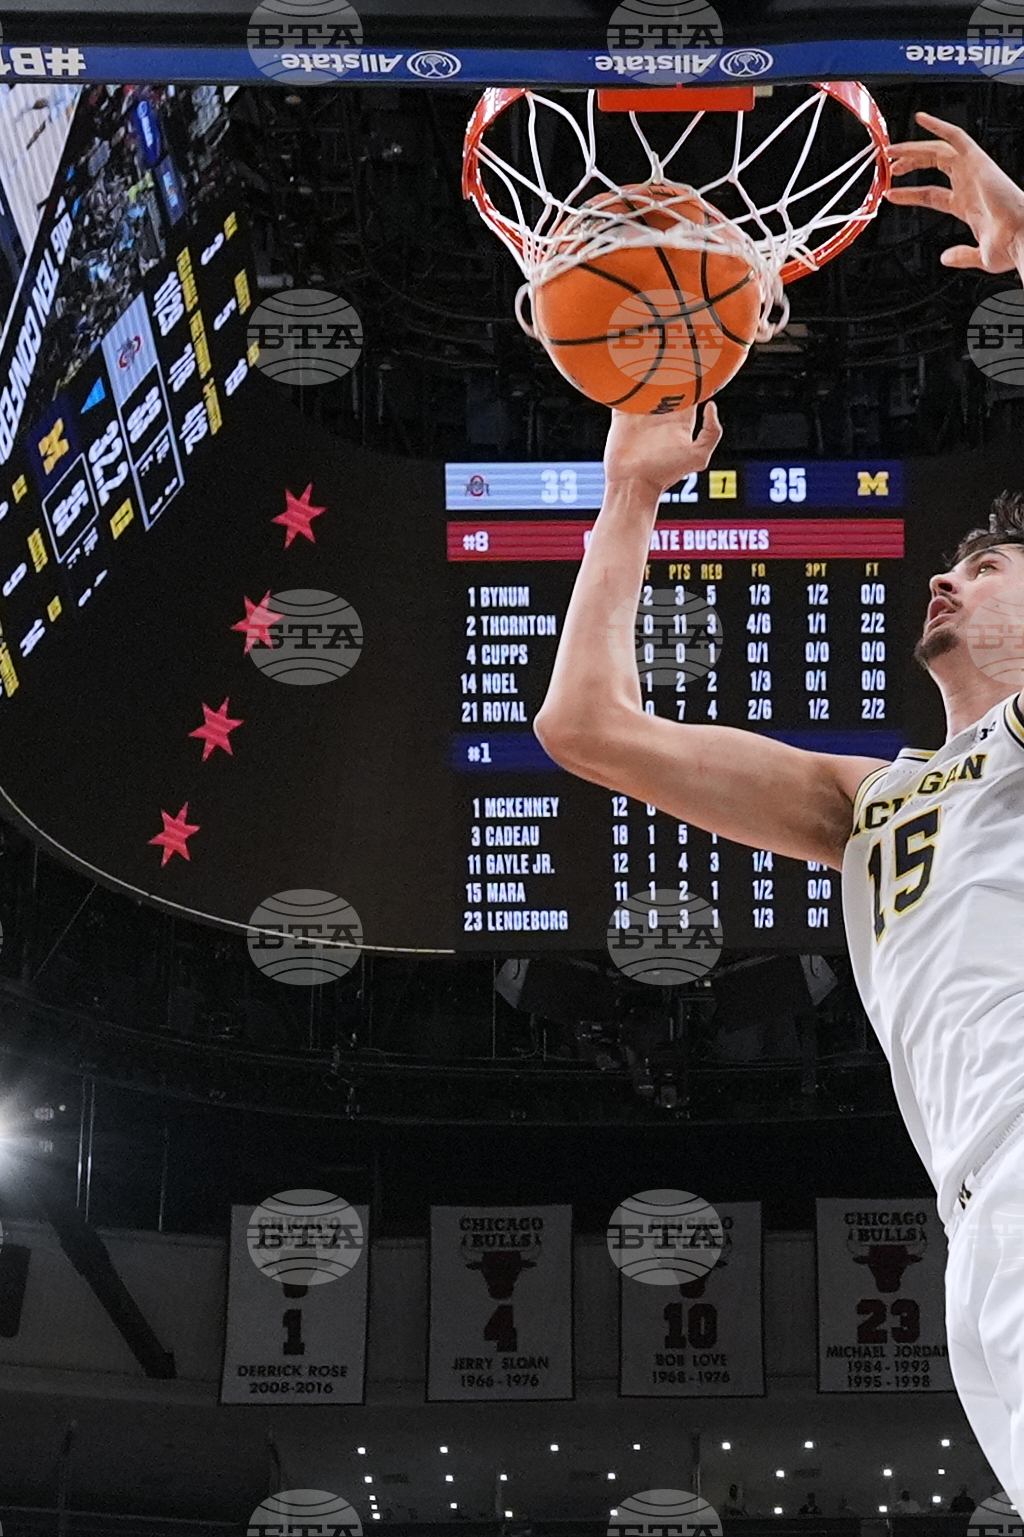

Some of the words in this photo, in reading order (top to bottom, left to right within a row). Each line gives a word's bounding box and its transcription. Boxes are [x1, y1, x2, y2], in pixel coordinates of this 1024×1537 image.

[281, 52, 403, 73] Allstate
[594, 52, 718, 74] Allstate
[540, 470, 578, 503] 33
[769, 468, 806, 503] 35
[857, 472, 889, 496] M
[463, 531, 488, 551] #8
[650, 530, 680, 550] ATE
[683, 529, 769, 550] BUCKEYES
[669, 564, 690, 580] PTS
[701, 564, 722, 580] REB
[806, 563, 826, 576] 3PT
[866, 563, 878, 576] FT
[468, 587, 475, 607] 1
[481, 587, 529, 607] BYNUM
[749, 584, 770, 605] 1/3
[807, 584, 828, 605] 1/2
[861, 583, 884, 604] 0/0
[467, 616, 476, 636] 2
[481, 615, 556, 636] THORNTON
[747, 613, 771, 634] 4/6
[808, 613, 825, 633] 1/1
[861, 612, 884, 633] 2/2
[467, 645, 476, 664] 4
[482, 644, 528, 665] CUPPS
[748, 642, 768, 663] 0/1
[806, 641, 829, 662] 0/0
[862, 641, 885, 662] 0/0
[461, 674, 476, 693] 14
[483, 673, 518, 693] NOEL
[751, 670, 771, 691] 1/3
[806, 670, 826, 691] 0/1
[862, 669, 885, 691] 0/0
[462, 702, 477, 722] 21
[483, 702, 527, 722] ROYAL
[748, 699, 772, 720] 2/6
[809, 698, 829, 719] 1/2
[862, 698, 885, 719] 2/2
[468, 743, 491, 762] #1
[473, 798, 479, 818] 1
[485, 797, 558, 817] MCKENNEY
[472, 826, 480, 846] 3
[486, 826, 539, 846] CADEAU
[468, 855, 481, 874] 11
[486, 854, 529, 874] GAYLE
[533, 854, 555, 873] JR.
[753, 848, 776, 872] 1/4
[868, 805, 942, 942] 15
[466, 883, 482, 902] 15
[487, 883, 525, 902] MARA
[753, 879, 773, 900] 1/2
[808, 879, 831, 899] 0/0
[464, 911, 482, 931] 23
[488, 910, 568, 931] LENDEBORG
[753, 908, 773, 928] 1/3
[808, 907, 828, 927] 0/1
[459, 1217, 543, 1231] CHICAGO
[843, 1212, 928, 1226] CHICAGO
[471, 1233, 531, 1247] BULLS
[858, 1227, 918, 1242] BULLS
[282, 1308, 305, 1355] 1
[483, 1304, 517, 1352] 4
[663, 1302, 718, 1349] 10
[857, 1298, 921, 1344] 23
[237, 1364, 301, 1378] DERRICK
[308, 1364, 348, 1378] ROSE
